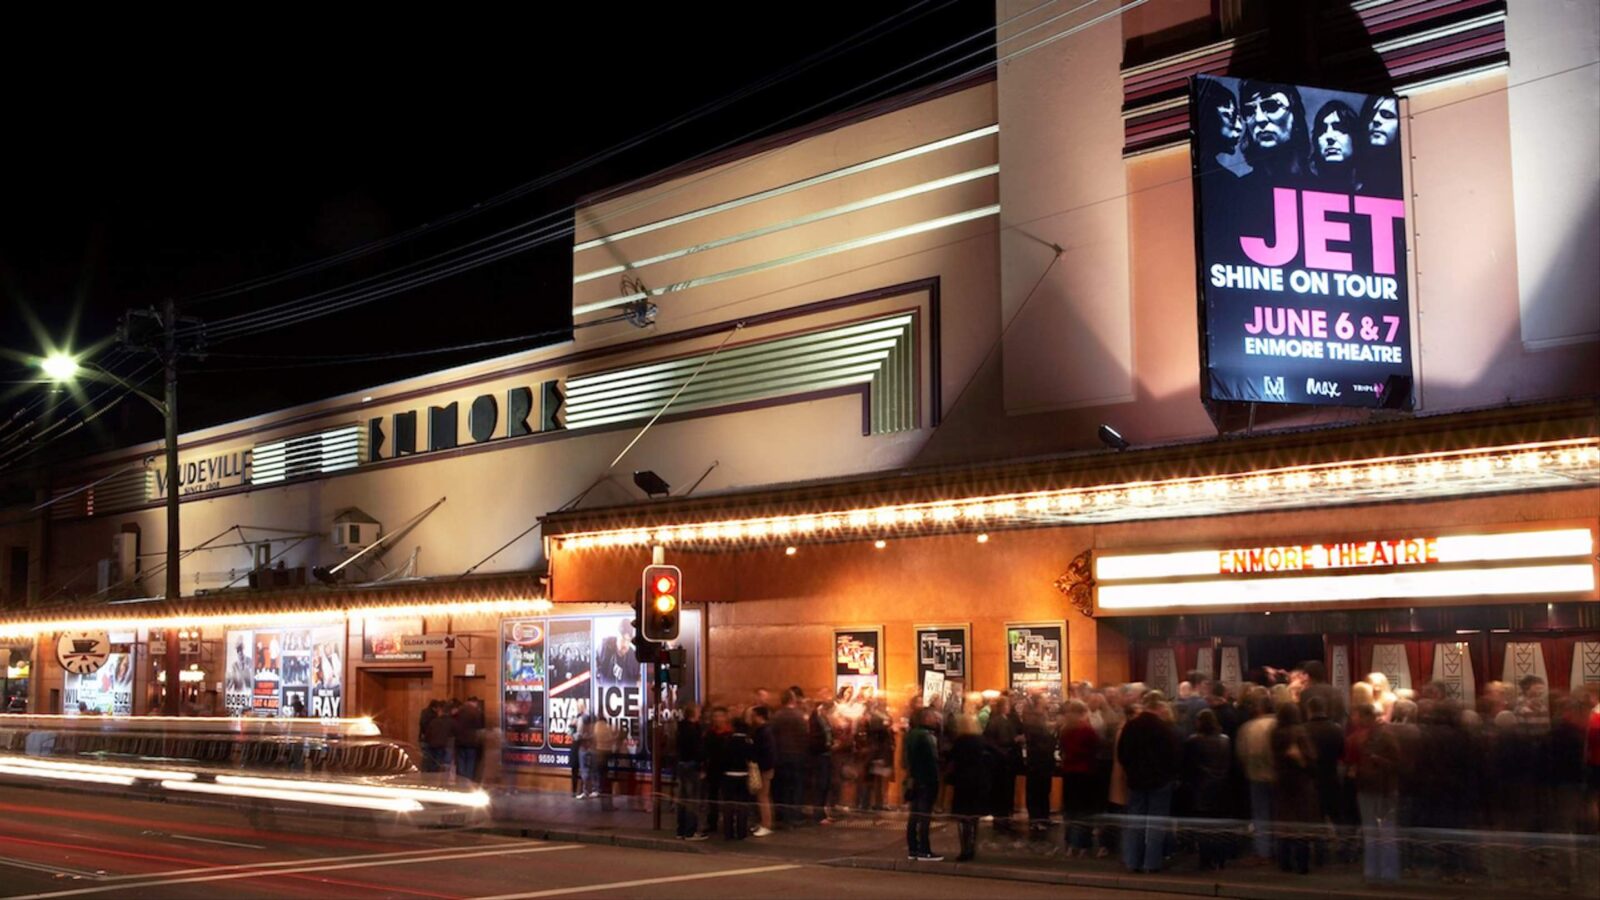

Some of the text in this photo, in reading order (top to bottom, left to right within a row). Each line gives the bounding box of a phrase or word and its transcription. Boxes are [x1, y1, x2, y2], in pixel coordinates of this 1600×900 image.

[1239, 187, 1406, 275] JET
[1210, 264, 1398, 300] SHINE ON TOUR
[1244, 306, 1400, 343] JUNE 6 & 7
[1244, 337, 1402, 363] ENMORE THEATRE
[368, 379, 566, 461] ENMORE
[156, 449, 253, 497] VUDEVILLE
[1218, 537, 1439, 574] ENMORE THEATRE
[312, 696, 340, 717] RAY
[597, 686, 640, 719] ICE
